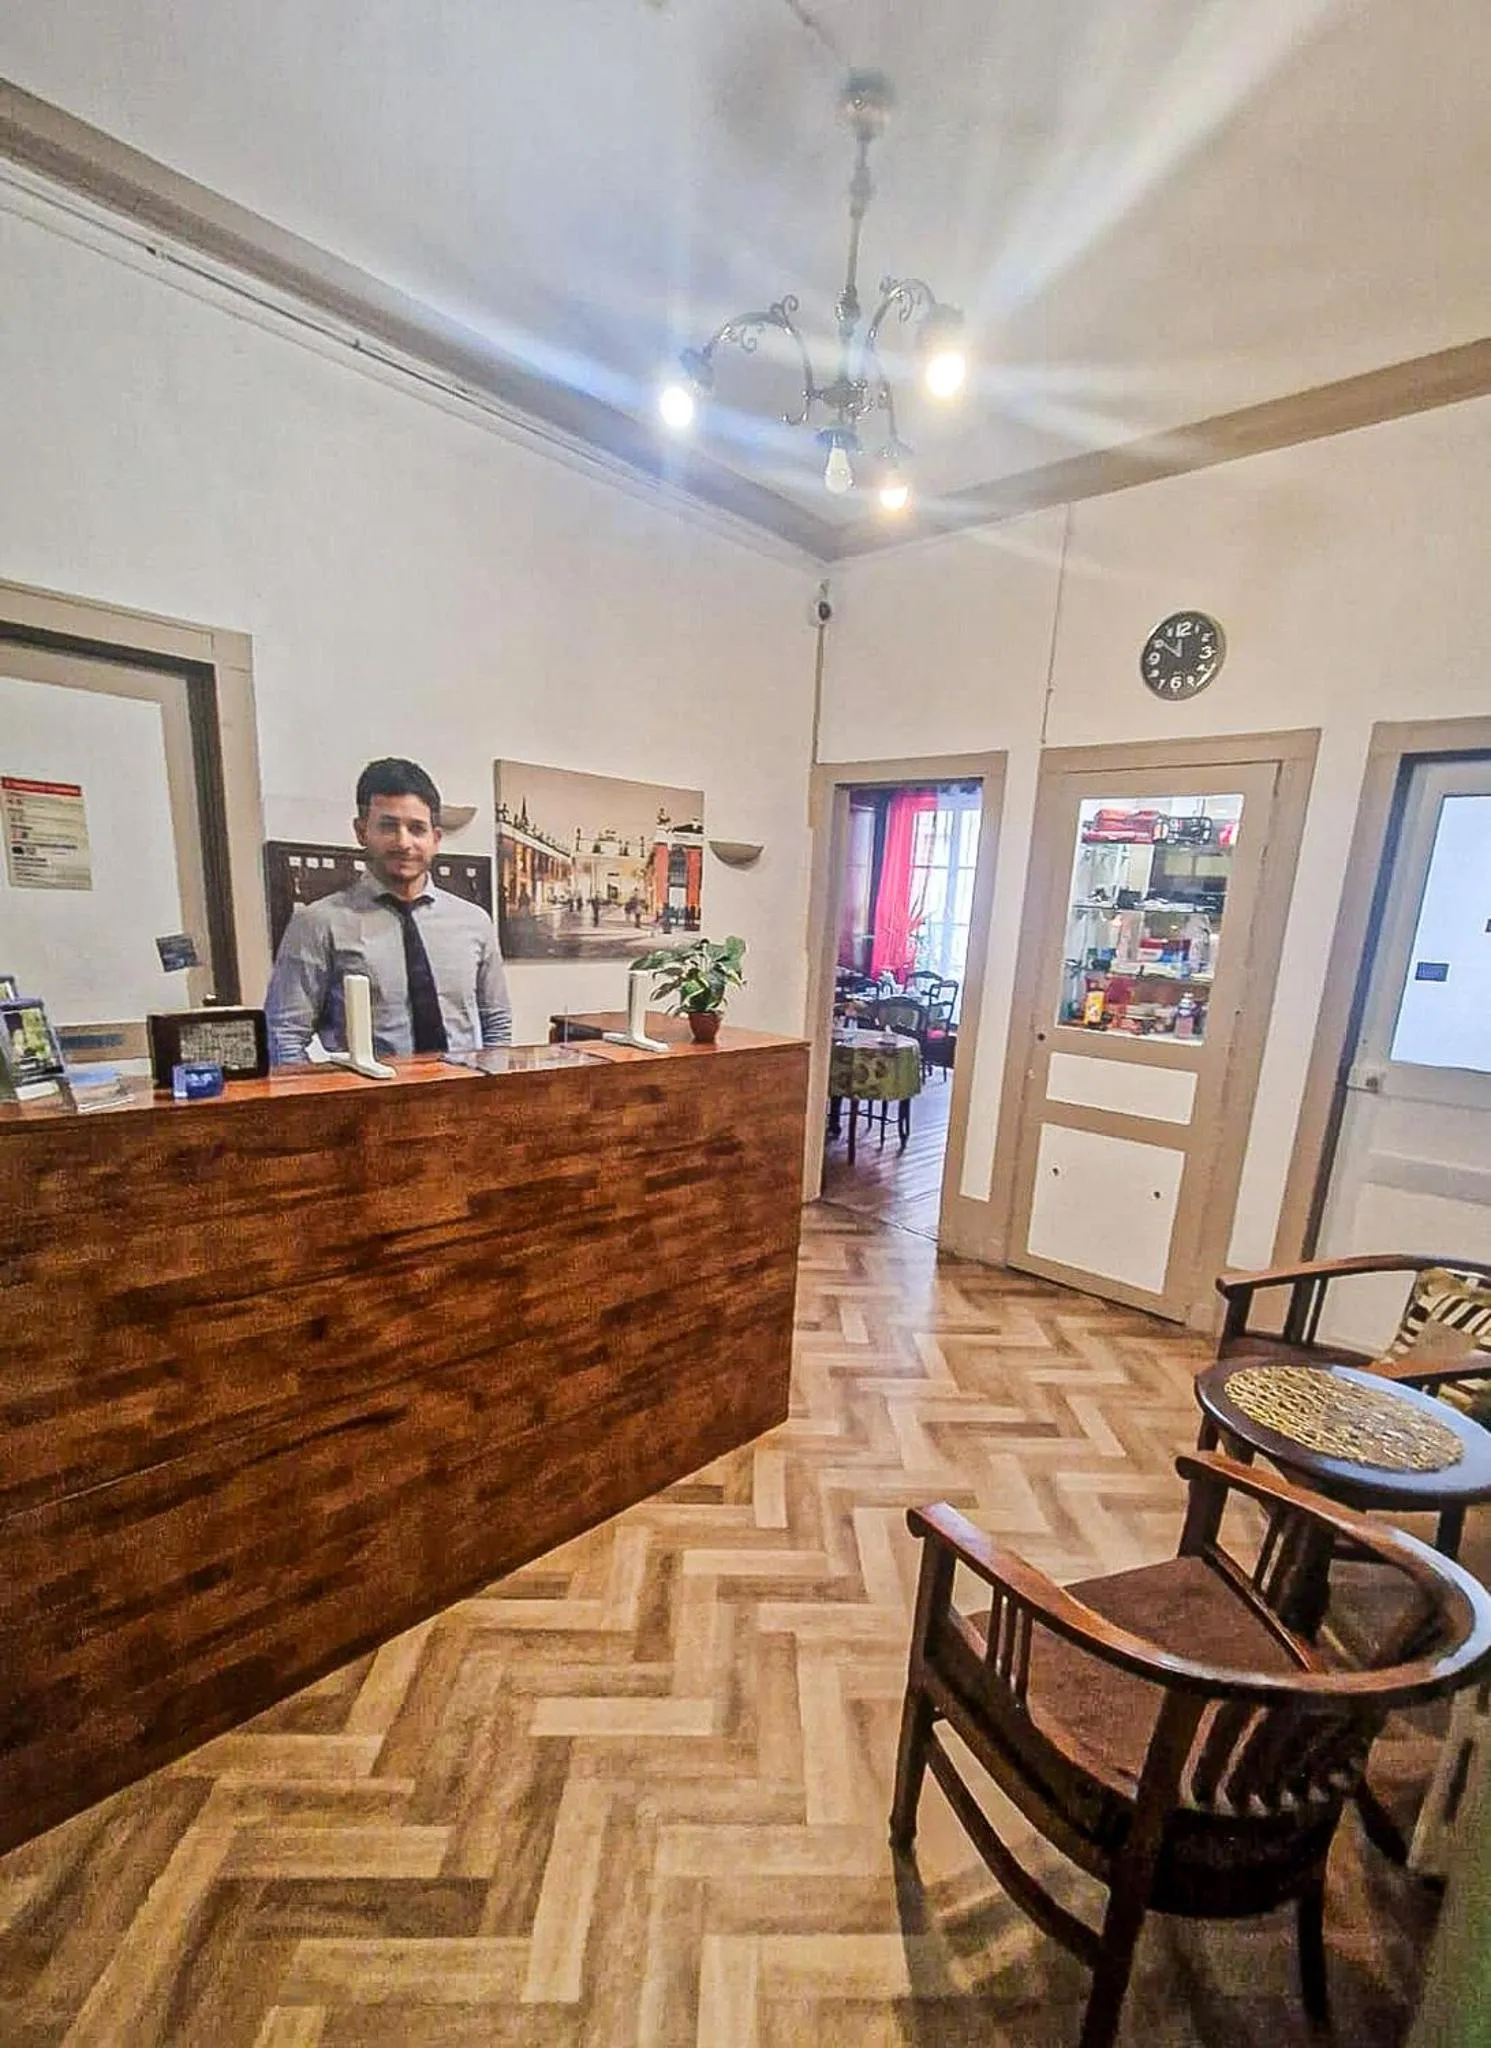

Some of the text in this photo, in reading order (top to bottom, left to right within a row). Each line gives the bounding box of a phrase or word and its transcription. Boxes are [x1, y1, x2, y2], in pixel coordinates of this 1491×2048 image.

[1176, 621, 1192, 637] 12
[1147, 652, 1161, 665] 9
[1199, 646, 1213, 659] 3
[1170, 676, 1182, 689] 6
